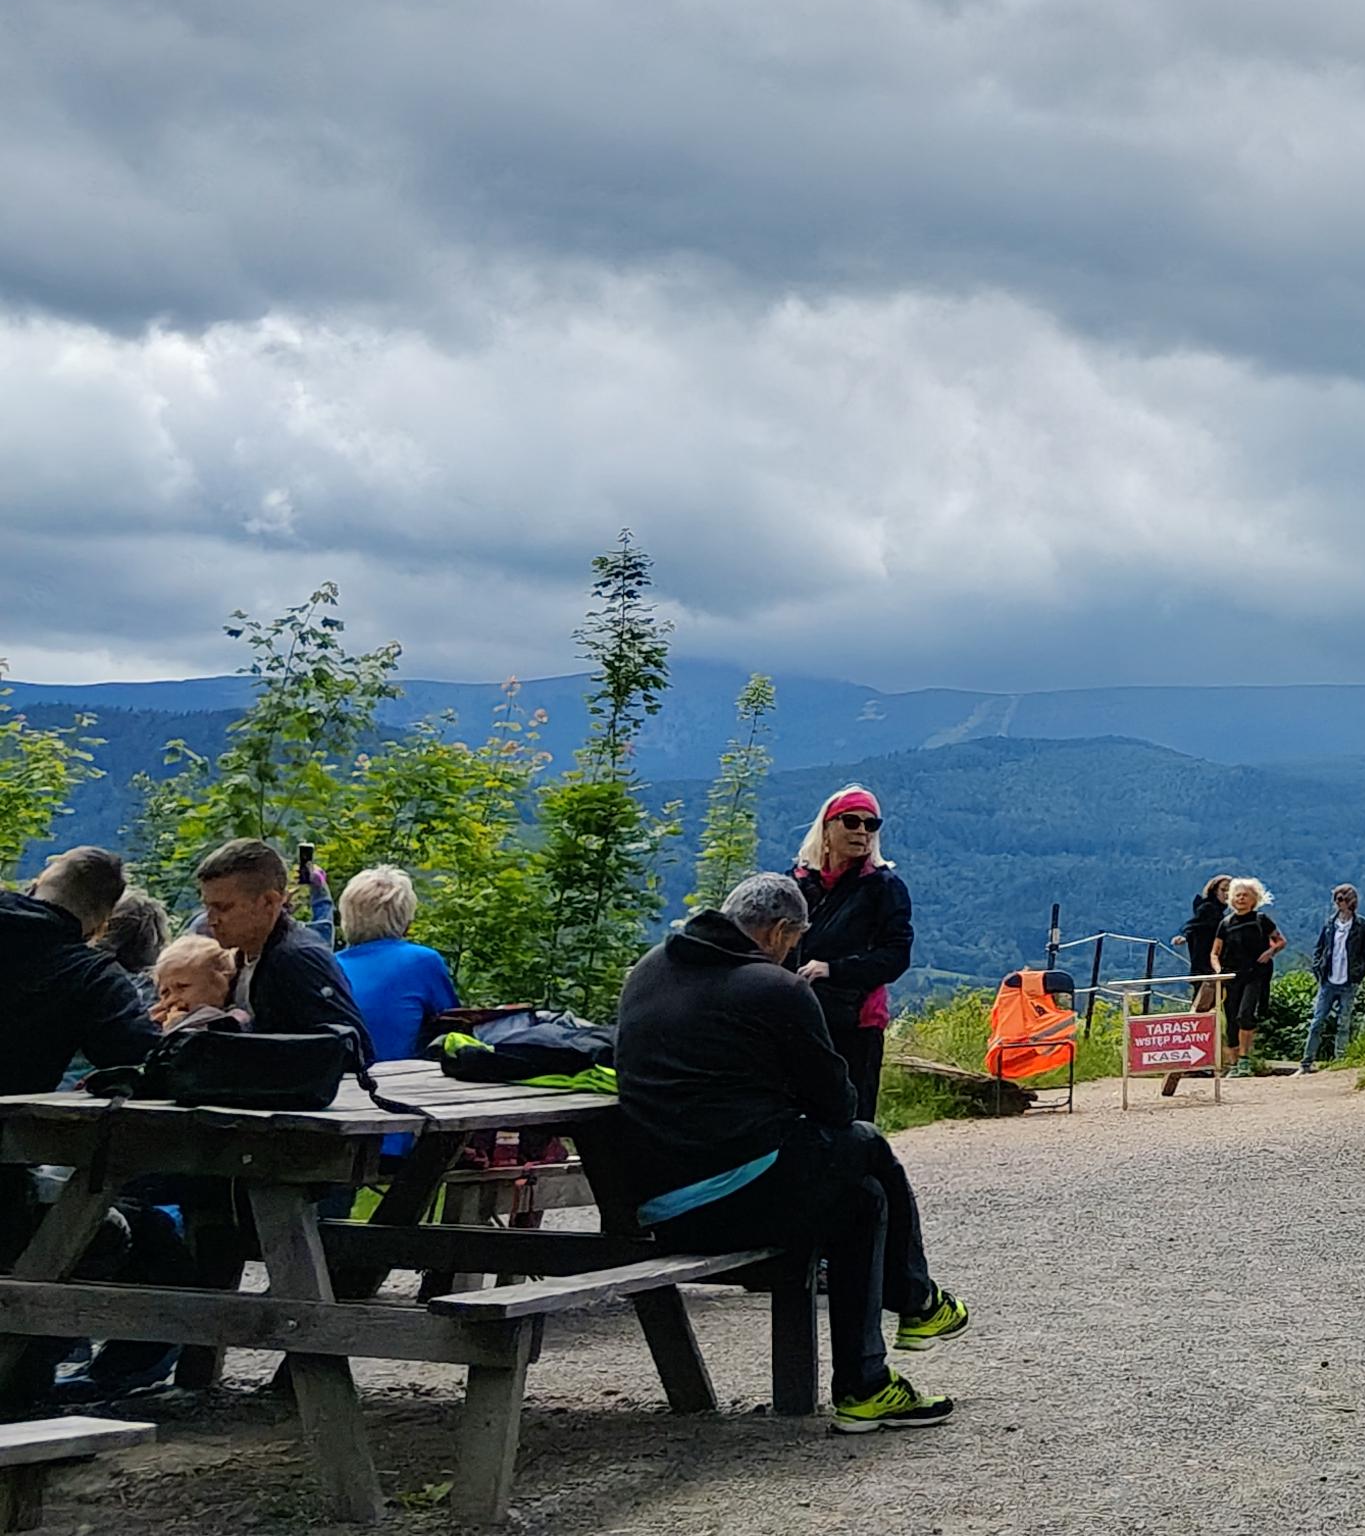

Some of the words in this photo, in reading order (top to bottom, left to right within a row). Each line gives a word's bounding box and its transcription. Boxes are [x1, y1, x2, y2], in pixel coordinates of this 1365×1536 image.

[1146, 1021, 1200, 1035] TARASY
[1135, 1037, 1170, 1046] WSTĘP
[1148, 1051, 1192, 1061] KASA
